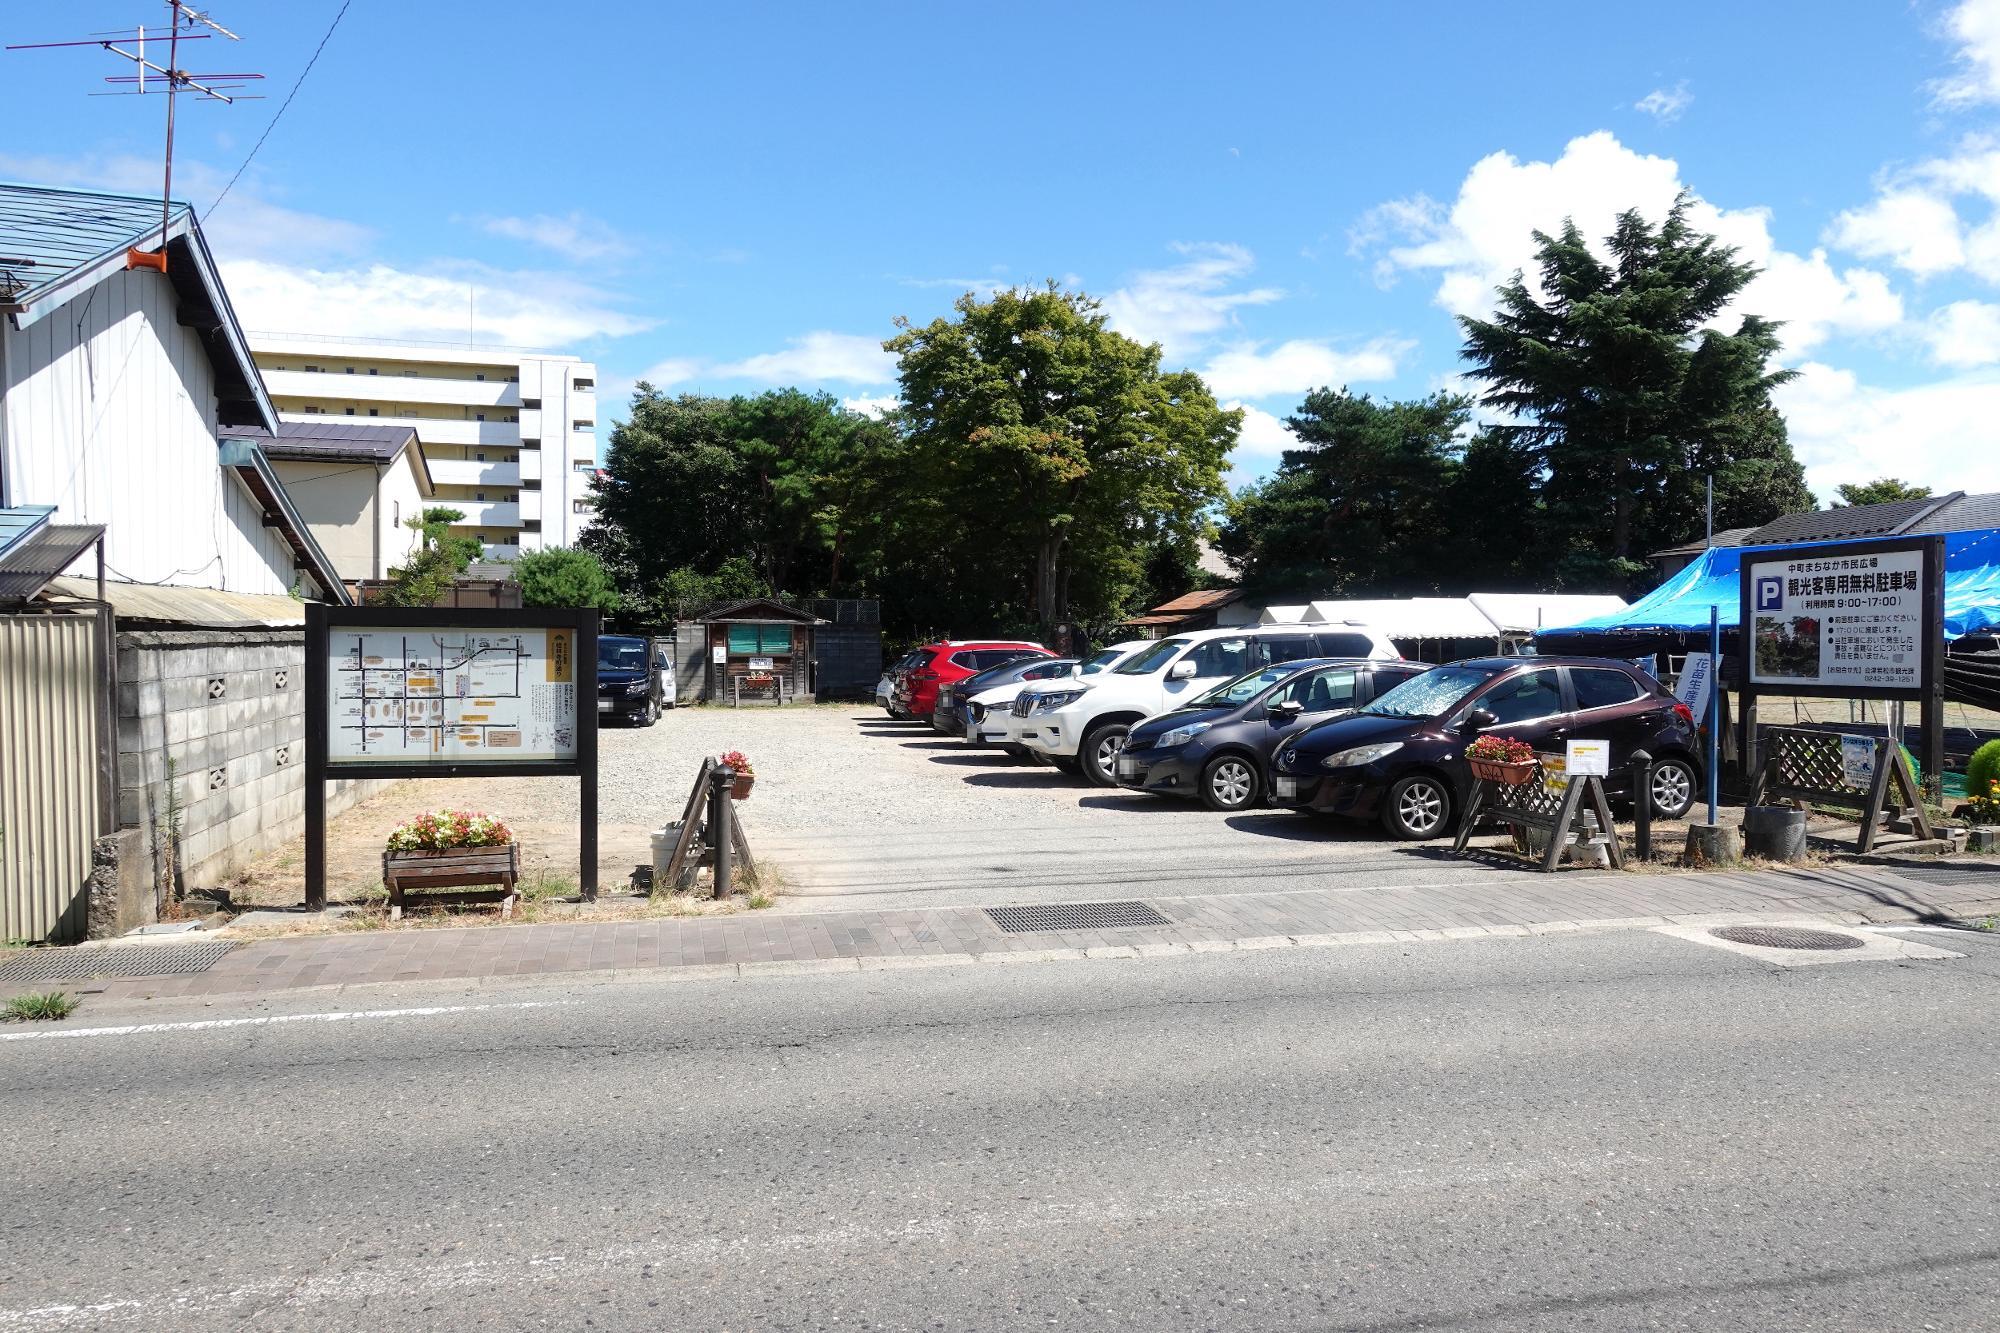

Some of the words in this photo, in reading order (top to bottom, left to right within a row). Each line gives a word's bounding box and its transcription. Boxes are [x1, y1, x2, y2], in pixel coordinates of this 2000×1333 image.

[1788, 557, 1878, 573] 中町まちなか市民広場
[1762, 581, 1780, 607] P
[1787, 570, 1918, 597] 観光客専用無料駐車場
